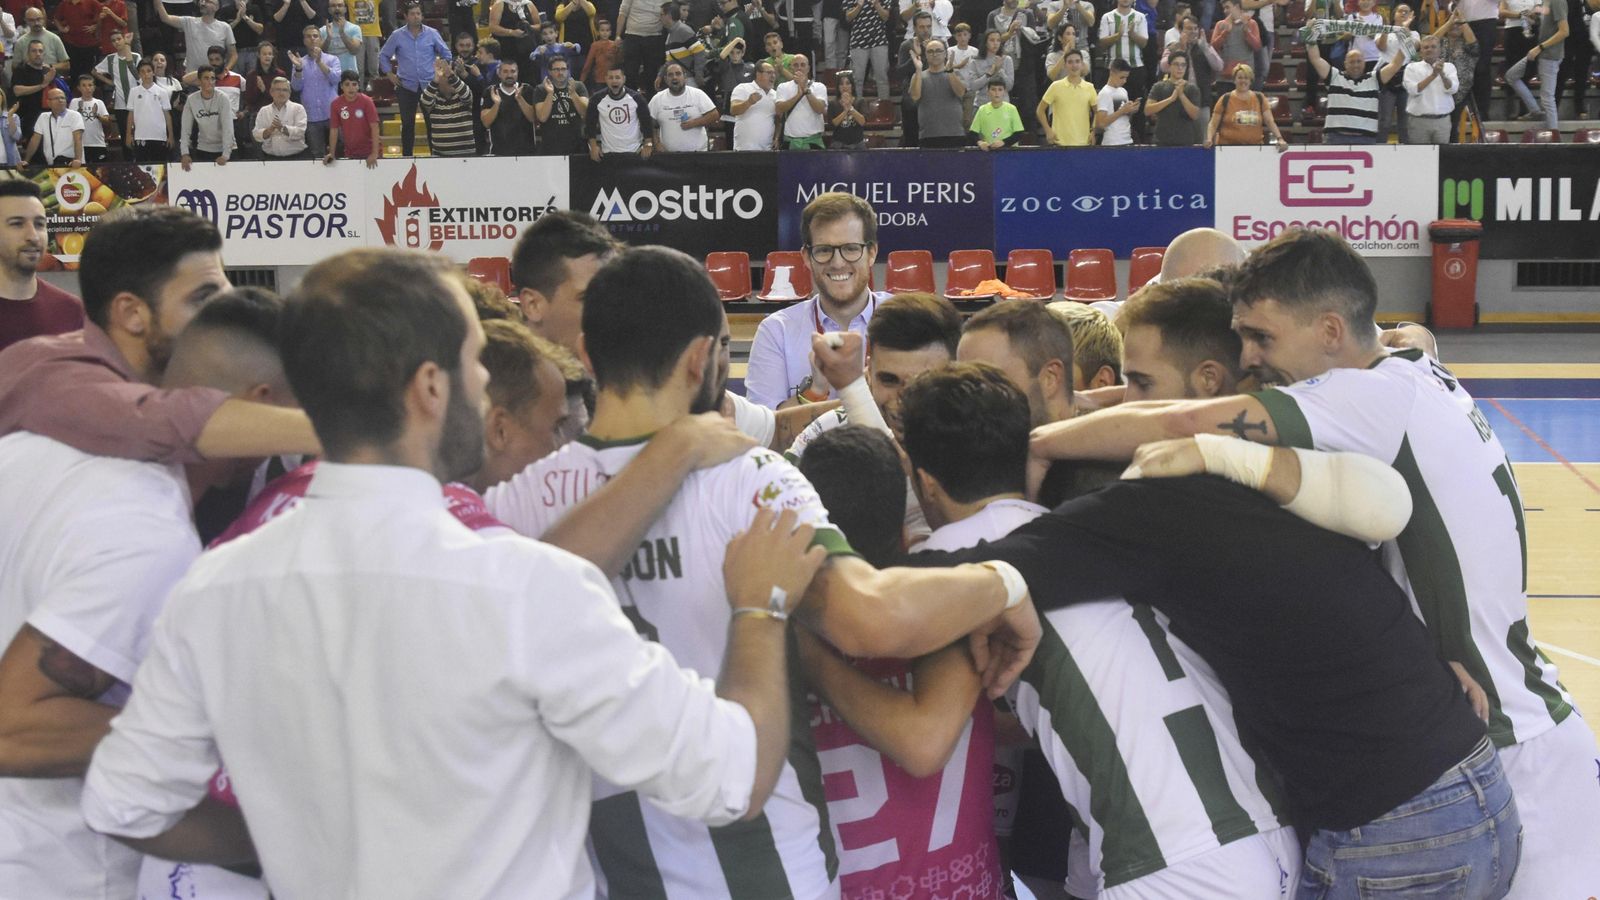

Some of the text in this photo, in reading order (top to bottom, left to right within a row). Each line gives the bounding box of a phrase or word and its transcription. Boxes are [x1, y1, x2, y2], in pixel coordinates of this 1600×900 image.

[225, 192, 347, 212] BOBINADOS
[589, 185, 763, 221] Mosttro
[908, 182, 976, 204] PERIS
[1496, 177, 1600, 221] MIL
[1001, 196, 1062, 213] zoc
[46, 213, 76, 223] rdura
[225, 213, 361, 239] PASTOR S.L.
[610, 223, 660, 232] RTWEAR
[873, 212, 928, 226] DOBA
[1233, 214, 1419, 242] Espolchón
[430, 223, 517, 240] BELLIDO
[1352, 240, 1420, 250] colchon.com
[619, 537, 683, 581] ON
